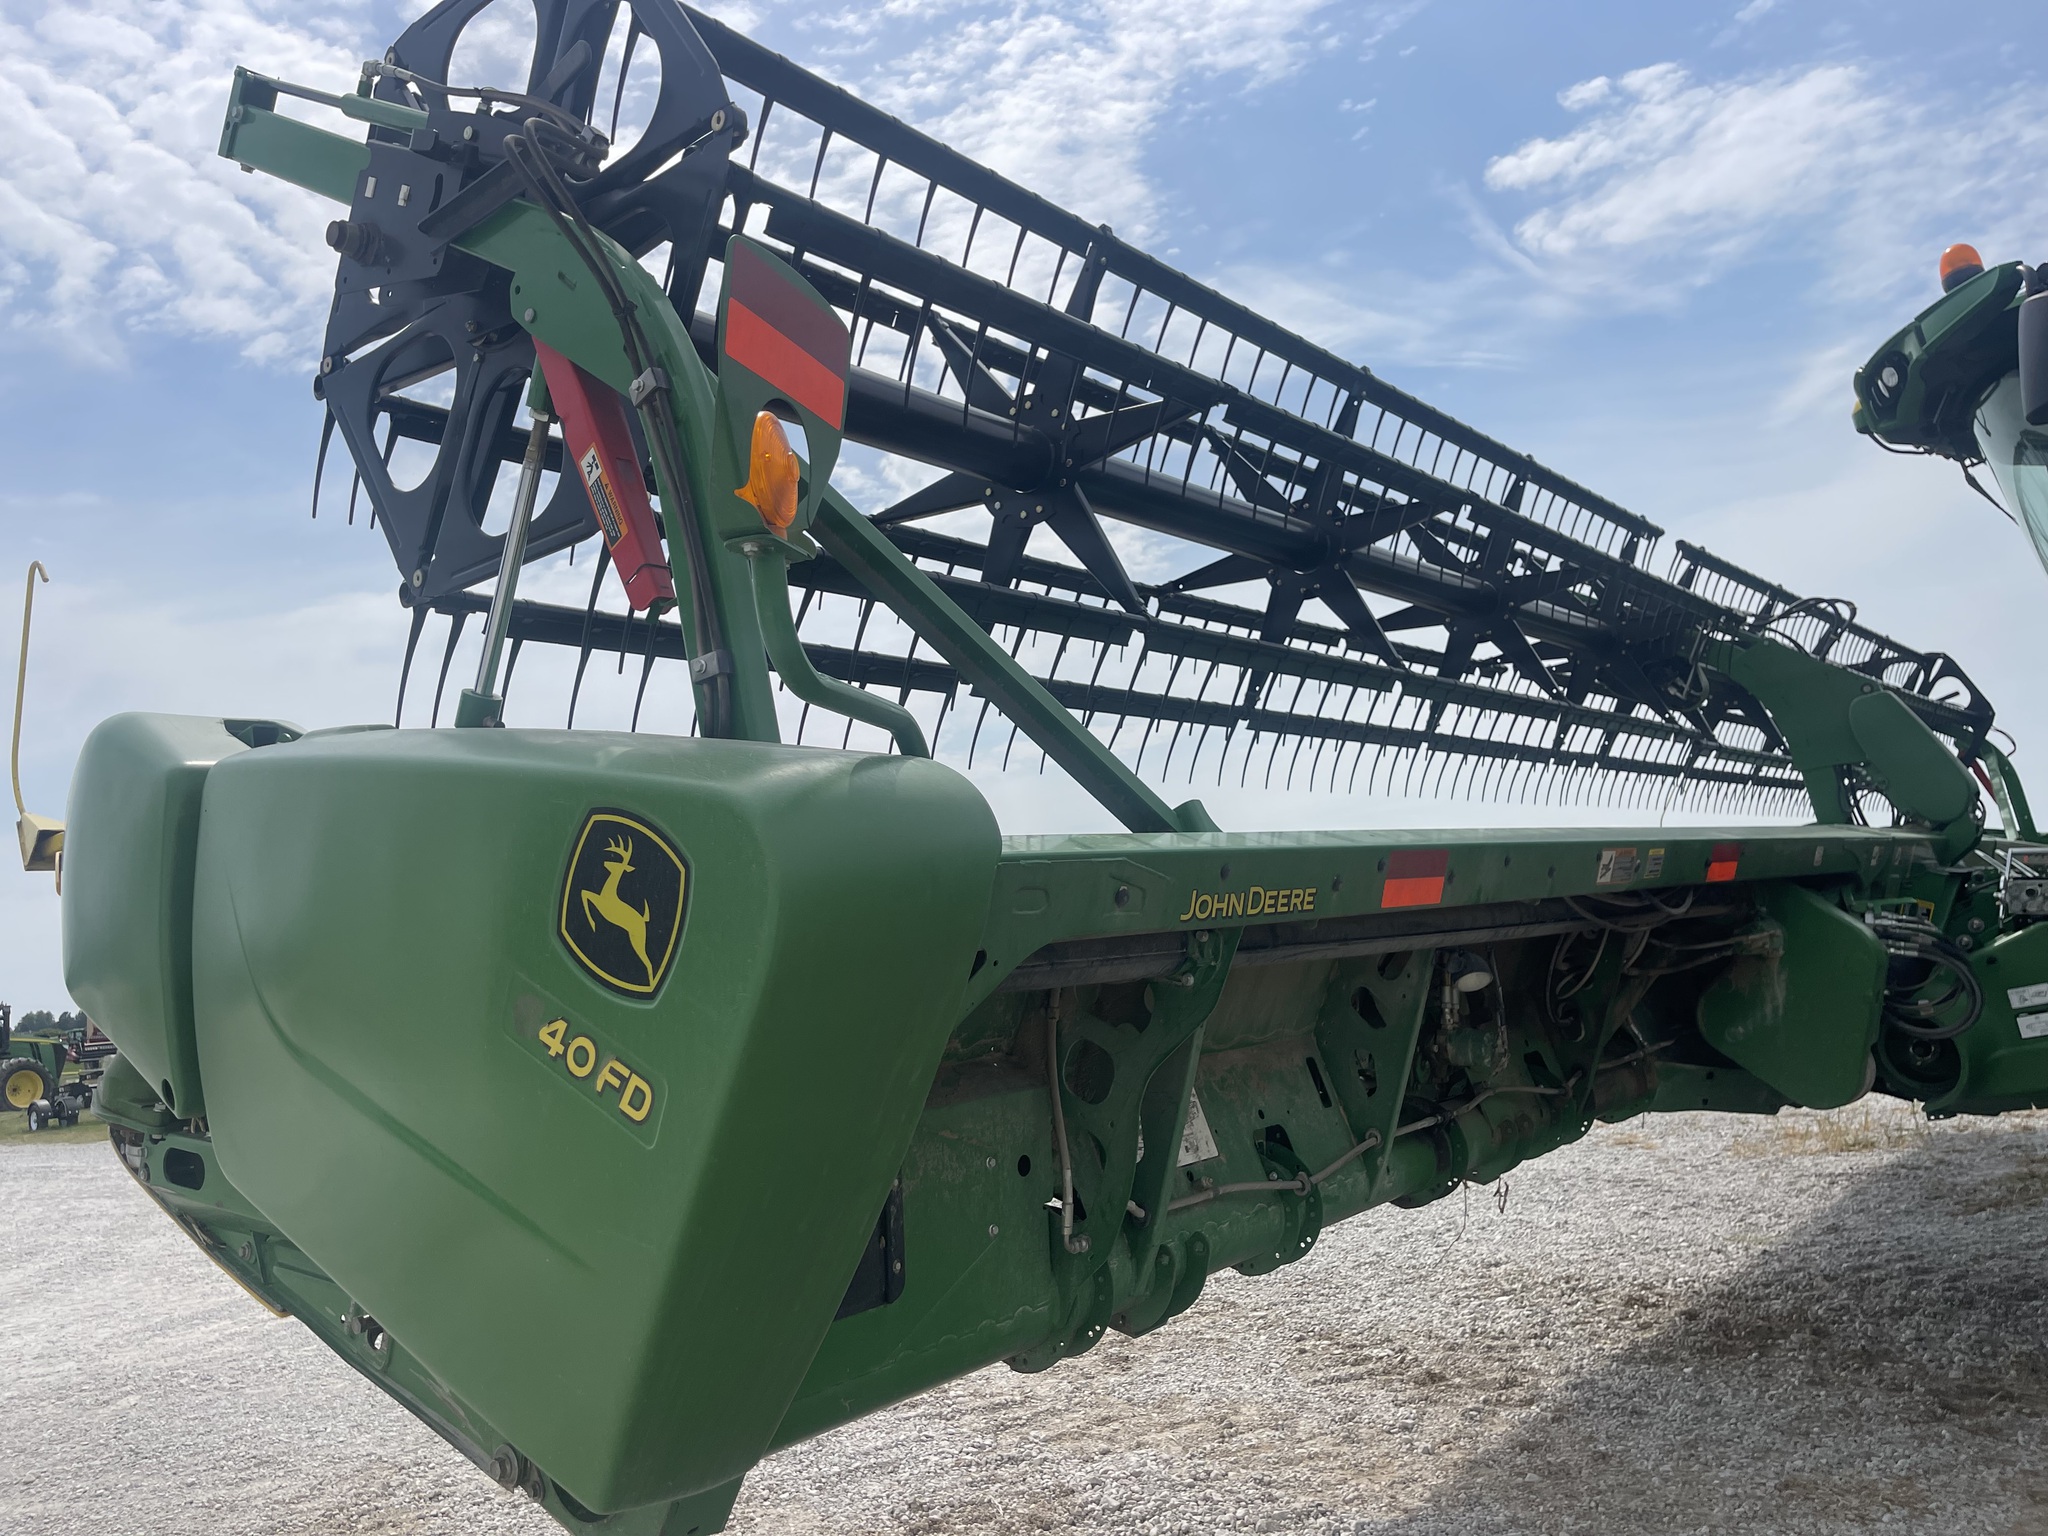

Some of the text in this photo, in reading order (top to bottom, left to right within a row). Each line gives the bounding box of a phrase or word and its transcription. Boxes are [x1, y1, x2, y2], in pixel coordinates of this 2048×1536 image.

[607, 489, 624, 526] WARNING
[1180, 886, 1318, 921] JOHN DEERE
